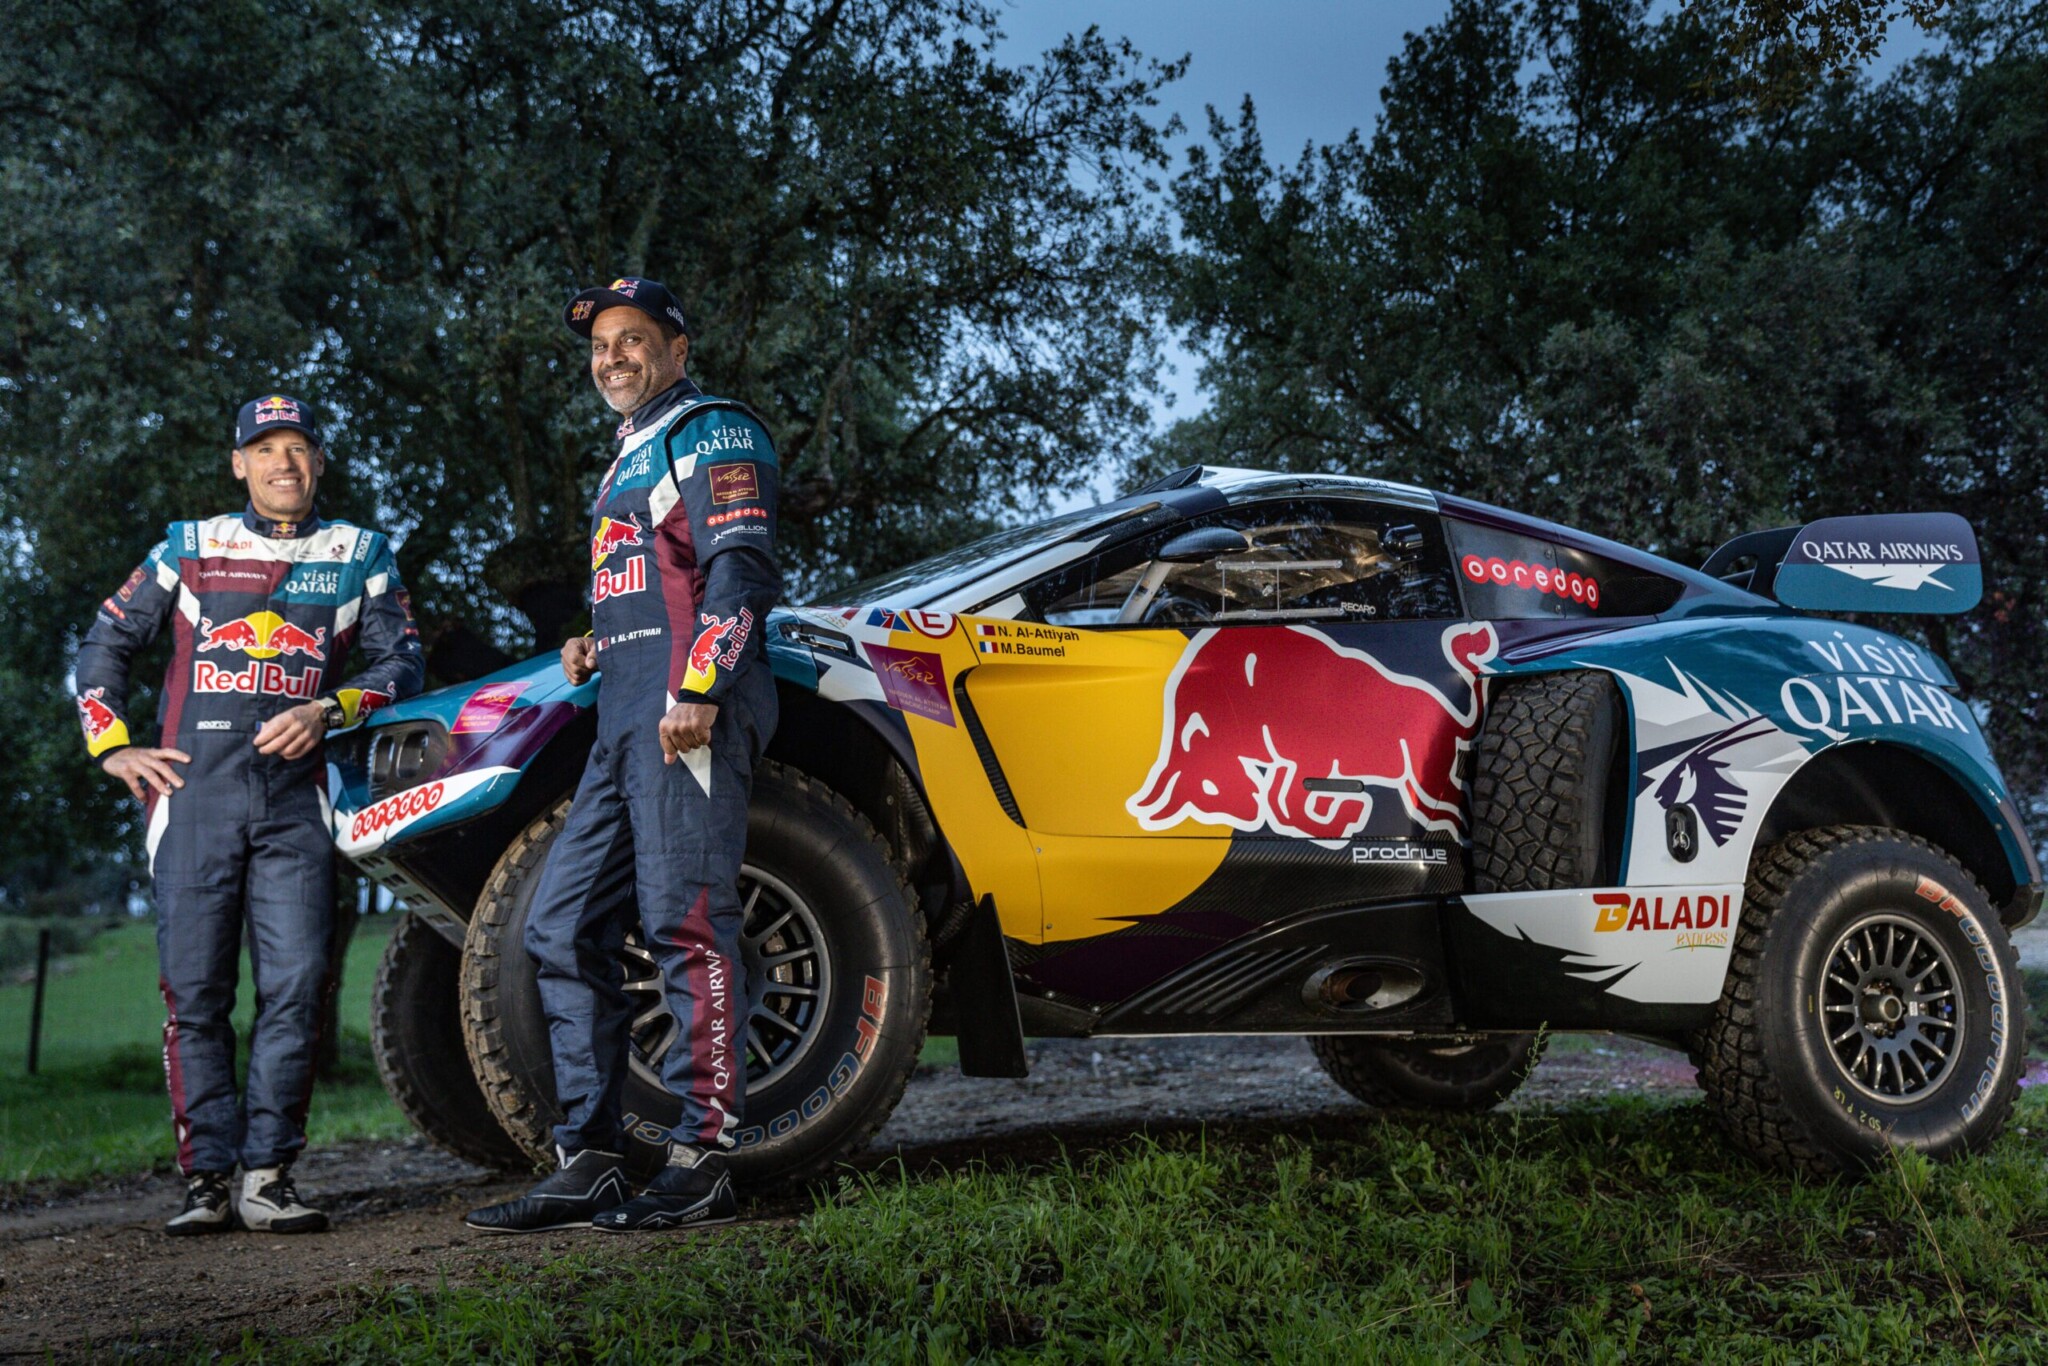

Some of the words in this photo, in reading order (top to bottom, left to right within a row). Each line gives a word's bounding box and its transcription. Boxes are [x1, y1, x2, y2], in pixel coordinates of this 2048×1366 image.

[712, 425, 752, 438] visit
[696, 438, 754, 455] QATAR
[707, 507, 768, 527] ooredoo
[1802, 541, 1876, 562] QATAR
[1879, 543, 1964, 561] AIRWAYS
[303, 569, 339, 582] visit
[594, 555, 646, 604] Bull
[1464, 555, 1599, 608] ooredoo
[285, 580, 337, 594] QATAR
[1341, 601, 1376, 615] RECARO
[717, 634, 744, 671] Red
[732, 606, 754, 642] Bull
[998, 626, 1012, 637] N.
[1017, 627, 1080, 643] Al-Attiyah
[1001, 643, 1066, 657] M.Baumel
[1808, 631, 1935, 683] visit
[195, 661, 259, 693] Red
[262, 663, 322, 699] Bull
[1780, 676, 1969, 741] QATAR
[352, 782, 444, 841] ooredoo
[1352, 843, 1447, 864] prodrive
[1593, 893, 1730, 932] BALADI
[1676, 931, 1728, 952] express
[711, 1018, 730, 1090] QATAR
